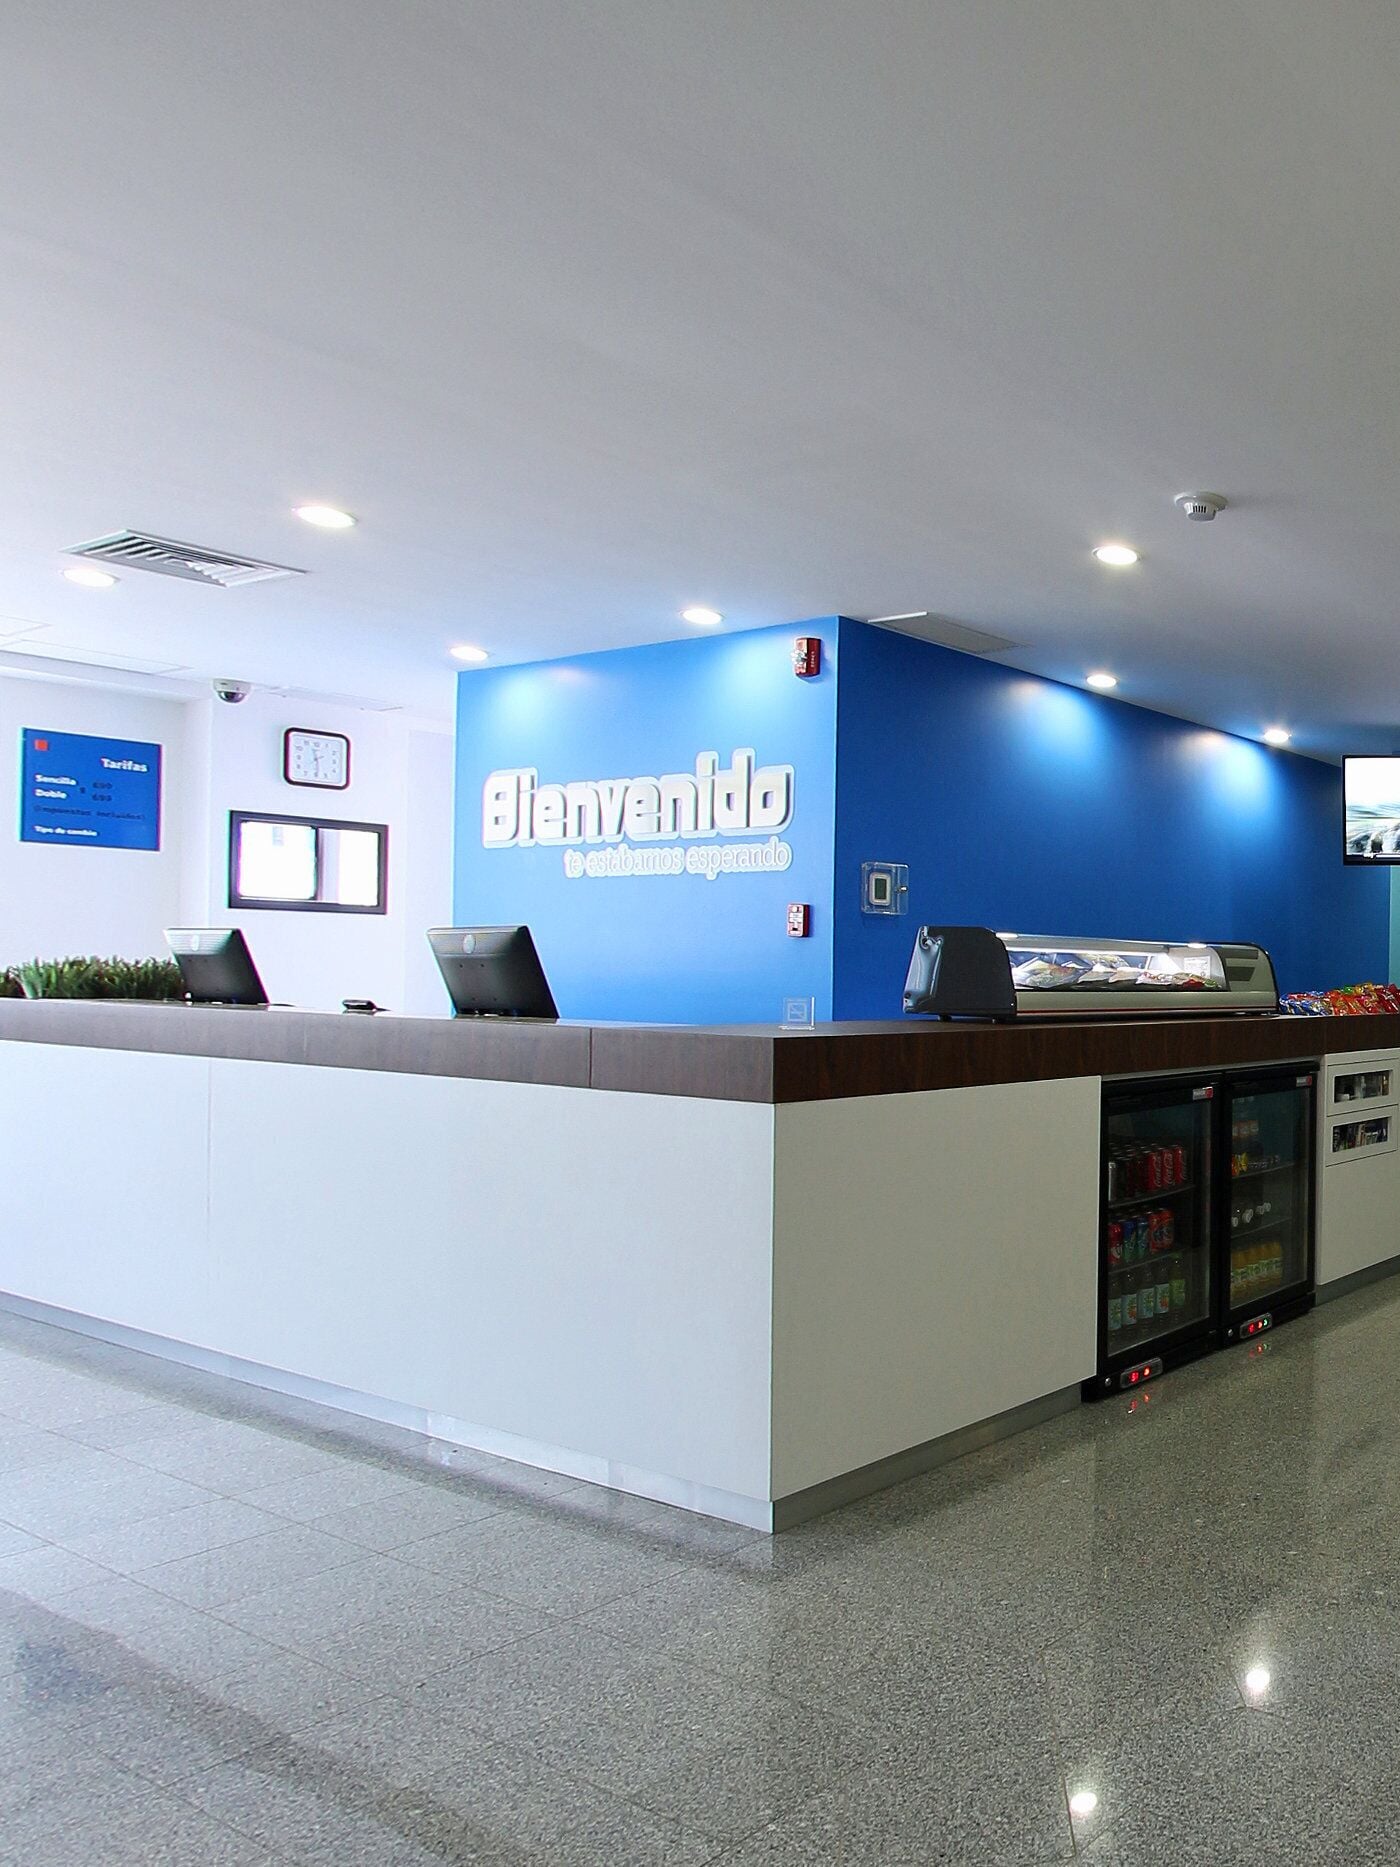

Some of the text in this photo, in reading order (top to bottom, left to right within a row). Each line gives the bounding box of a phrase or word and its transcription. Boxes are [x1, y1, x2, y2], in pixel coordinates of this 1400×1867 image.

[101, 757, 148, 772] Tarifas
[482, 752, 793, 843] Bienvenido
[687, 842, 790, 878] esperando
